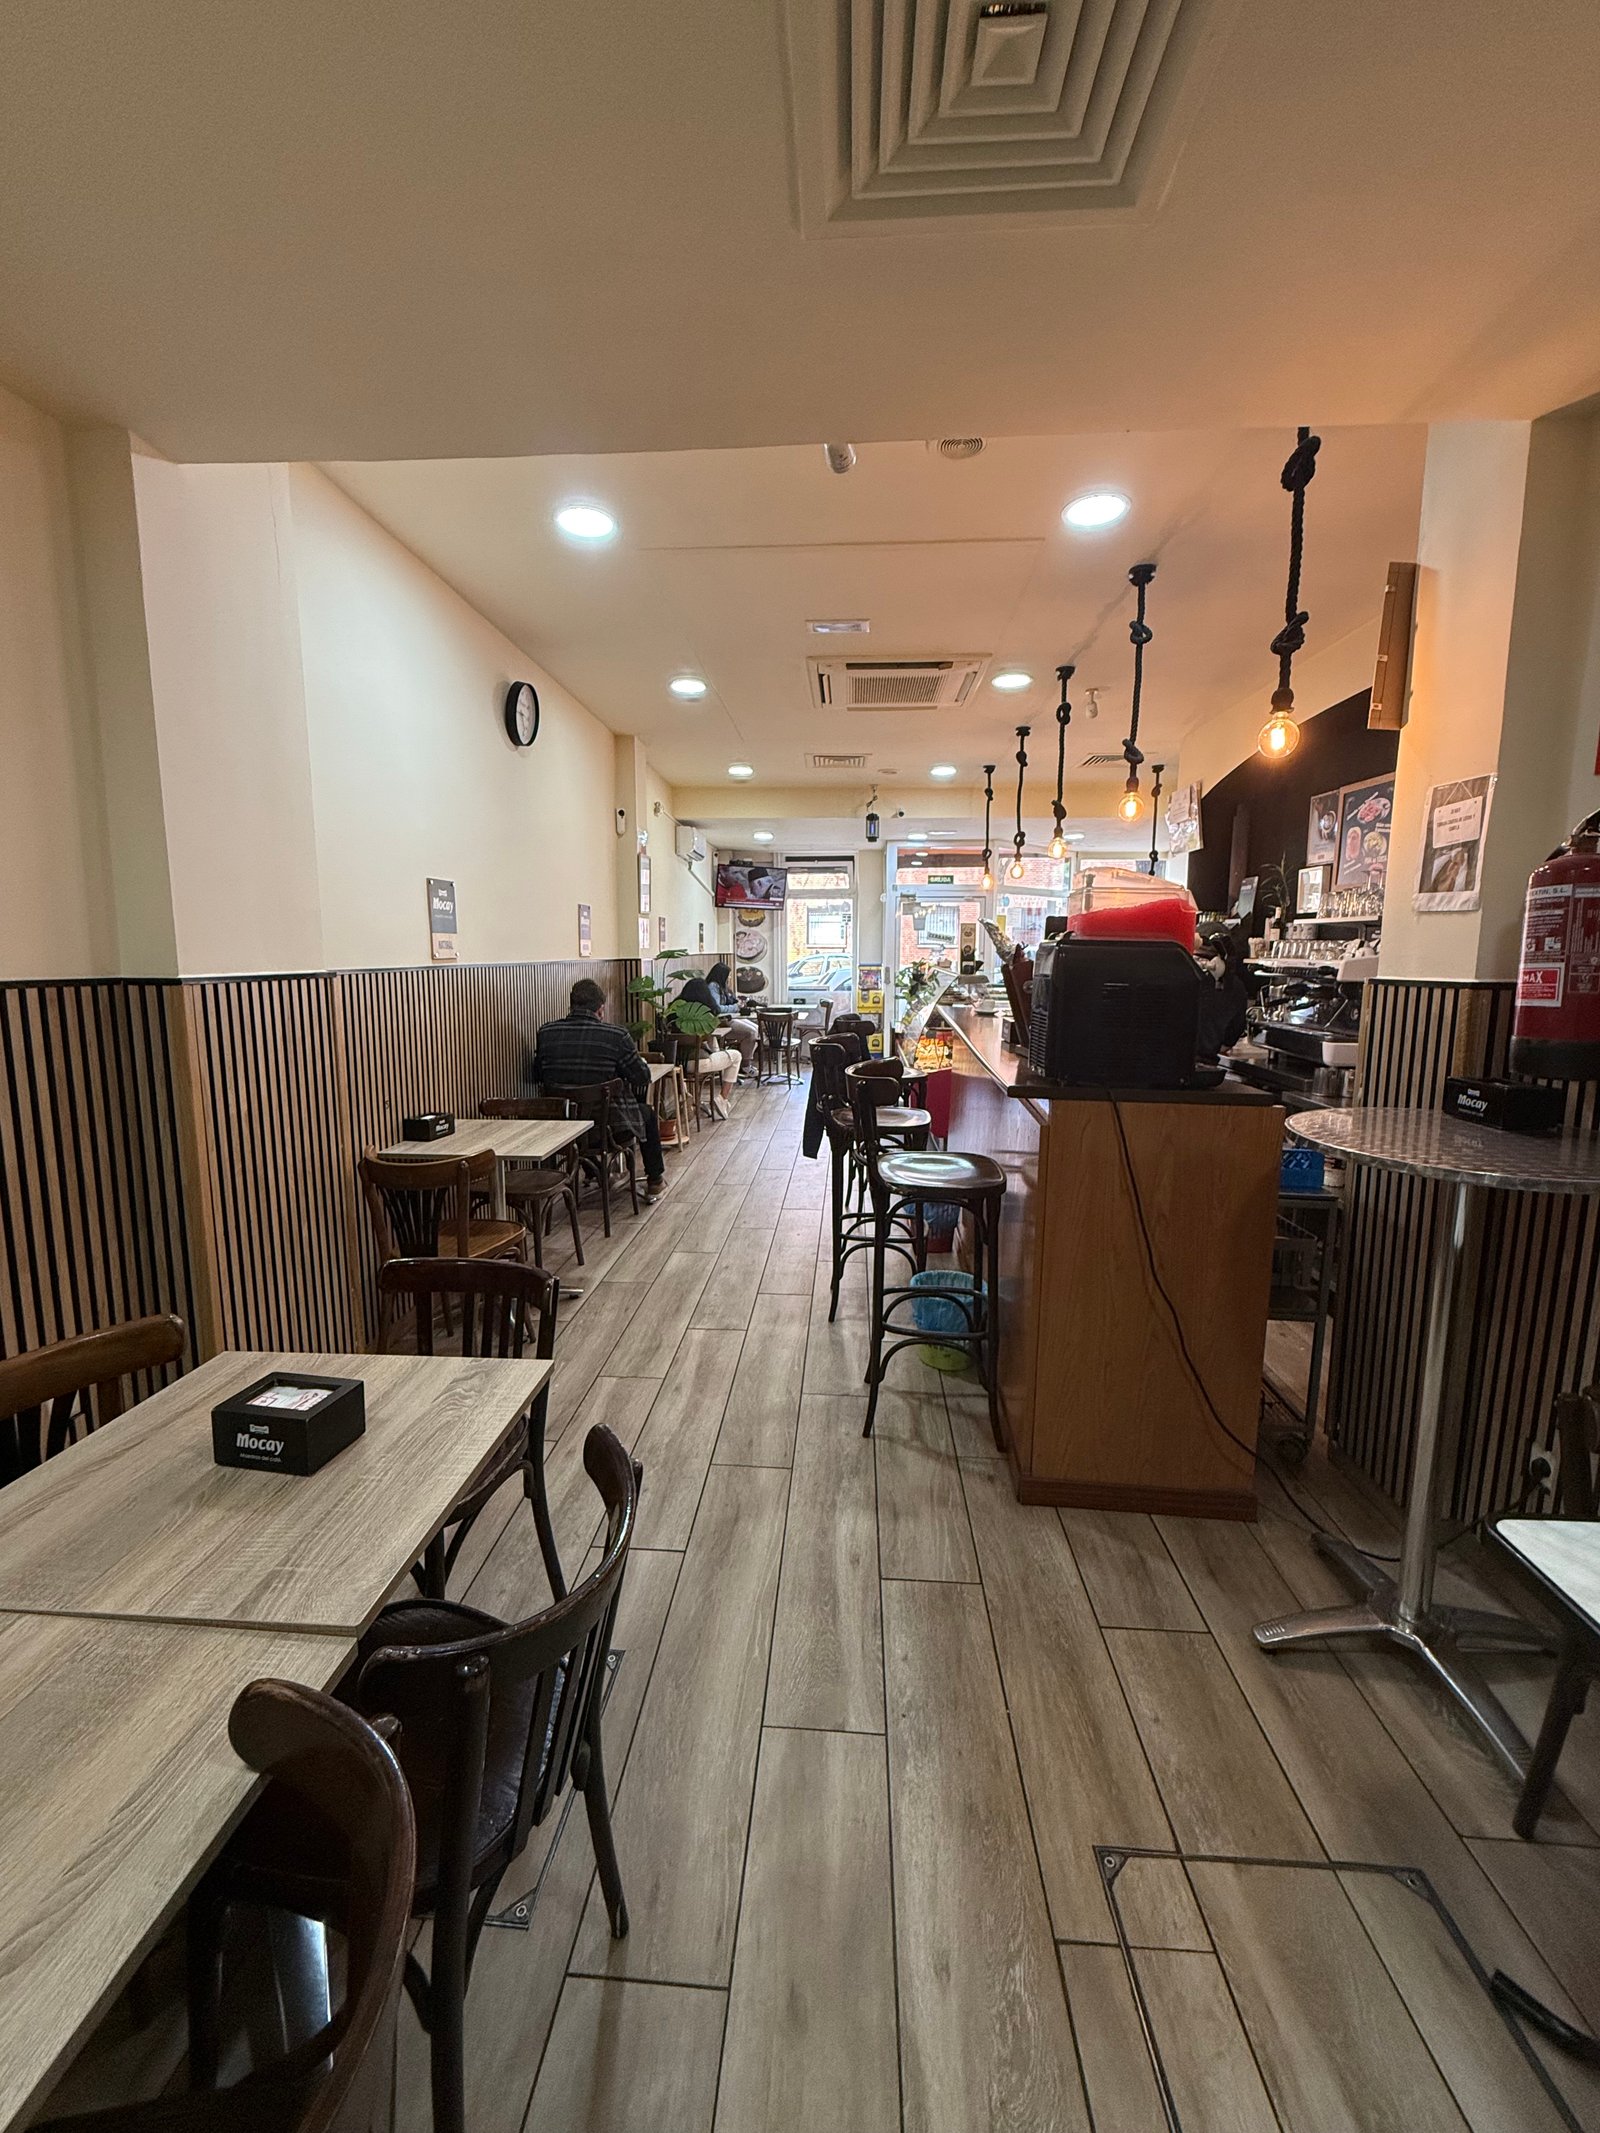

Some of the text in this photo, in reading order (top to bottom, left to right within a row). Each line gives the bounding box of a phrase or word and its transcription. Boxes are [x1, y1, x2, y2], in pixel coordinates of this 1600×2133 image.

[433, 897, 454, 914] Mocay
[1457, 1093, 1488, 1112] Mocay
[236, 1432, 284, 1456] Mocay
